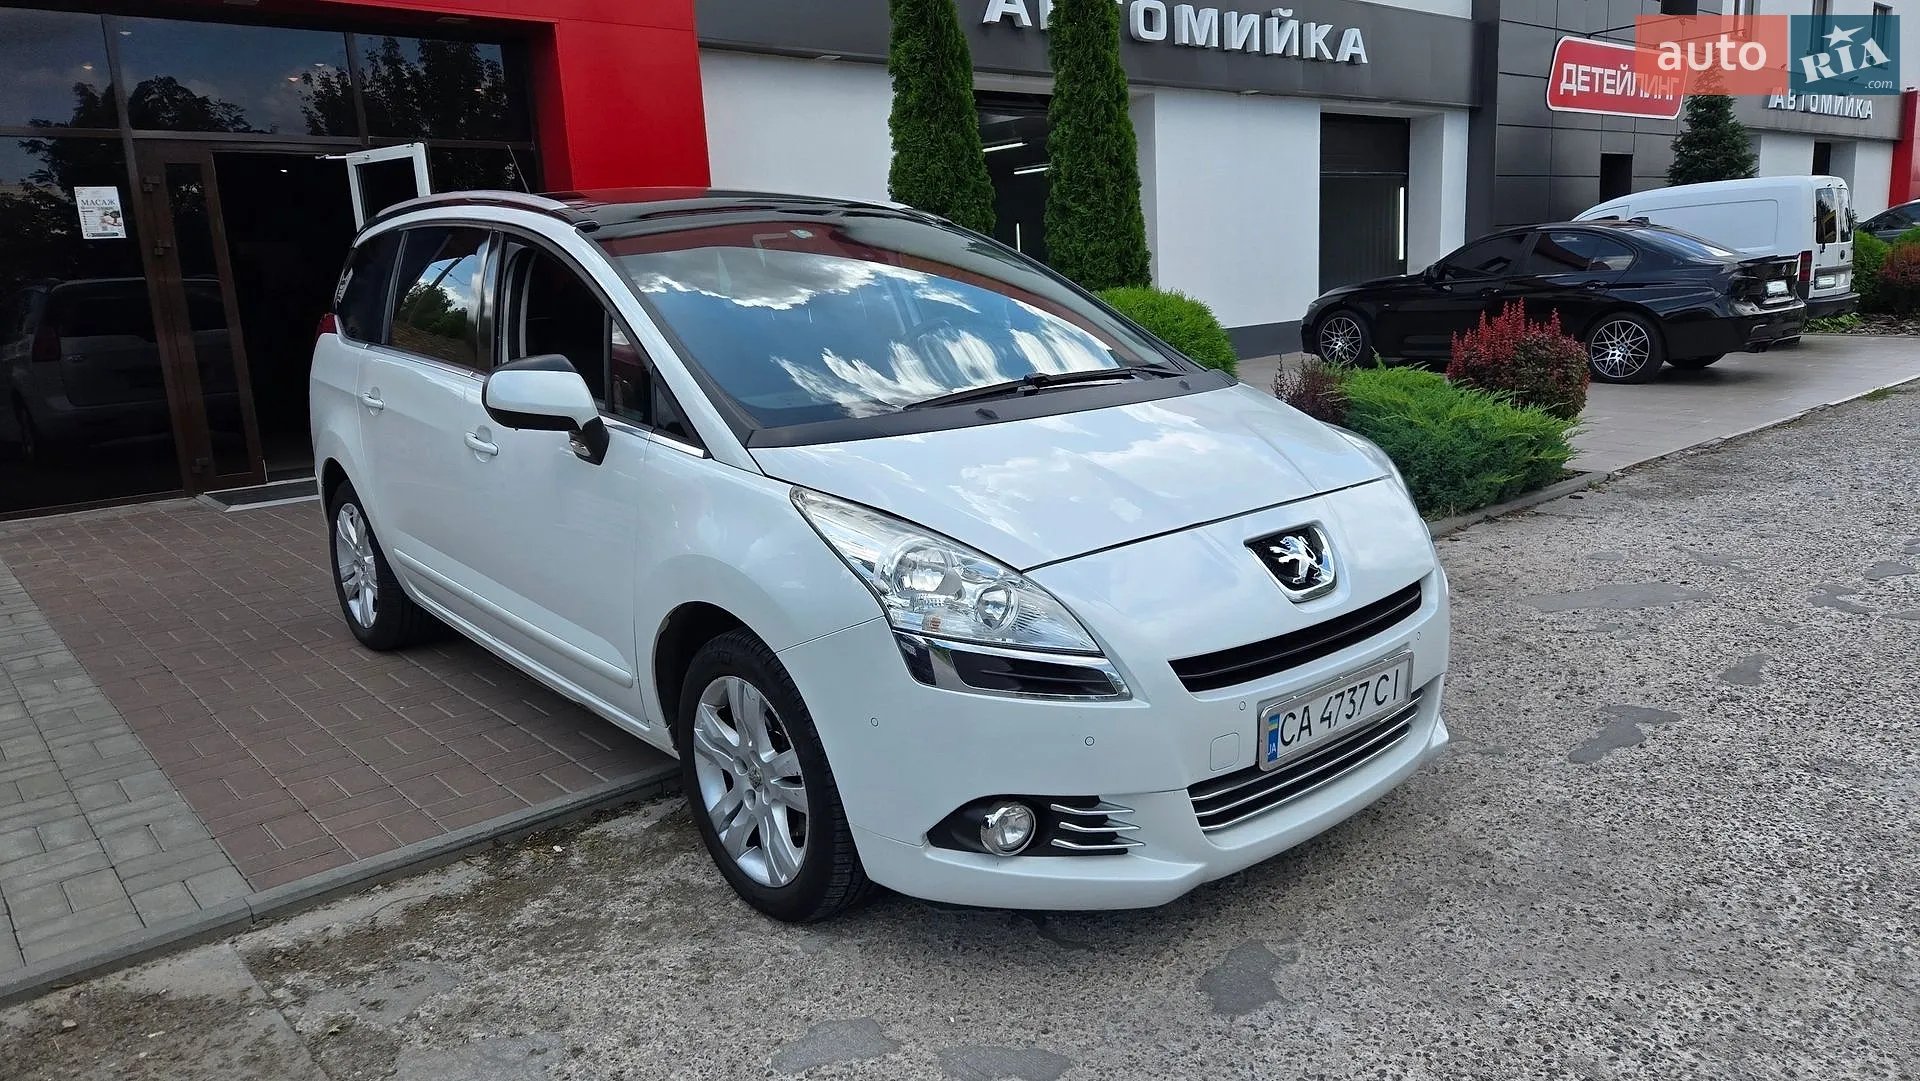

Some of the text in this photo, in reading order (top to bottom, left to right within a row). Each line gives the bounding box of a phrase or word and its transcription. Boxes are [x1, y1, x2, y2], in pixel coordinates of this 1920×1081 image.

[982, 0, 1369, 64] АОМИЙКА
[1559, 62, 1679, 101] ДЕТЕЙЛИНГ
[1768, 86, 1873, 119] АВТОМИЙКА
[1280, 668, 1399, 746] CA 4737 CI
